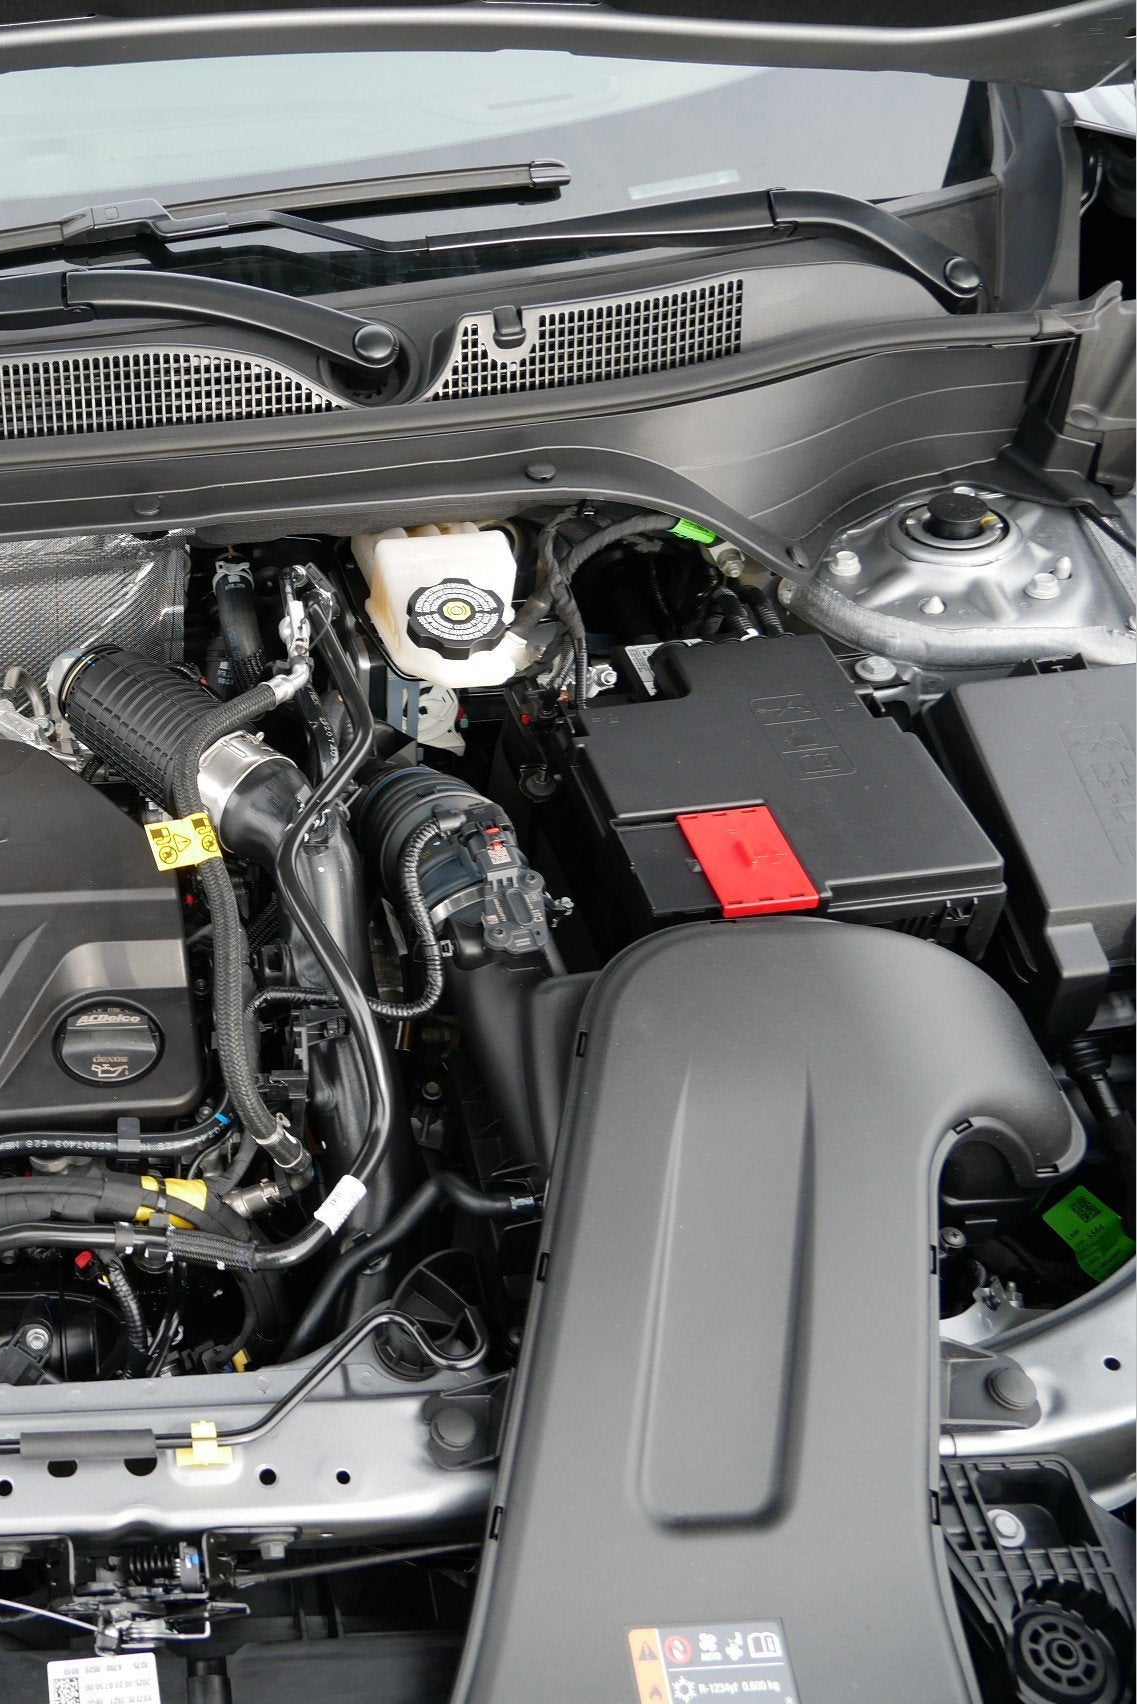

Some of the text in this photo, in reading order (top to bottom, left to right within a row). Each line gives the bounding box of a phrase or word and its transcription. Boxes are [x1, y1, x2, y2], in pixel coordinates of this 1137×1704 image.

[75, 1013, 141, 1026] ACDelco
[92, 1055, 129, 1063] dexos
[25, 1140, 48, 1148] 528
[700, 1652, 723, 1662] AUTO
[697, 1680, 781, 1695] R-1234yf 0.600 kg
